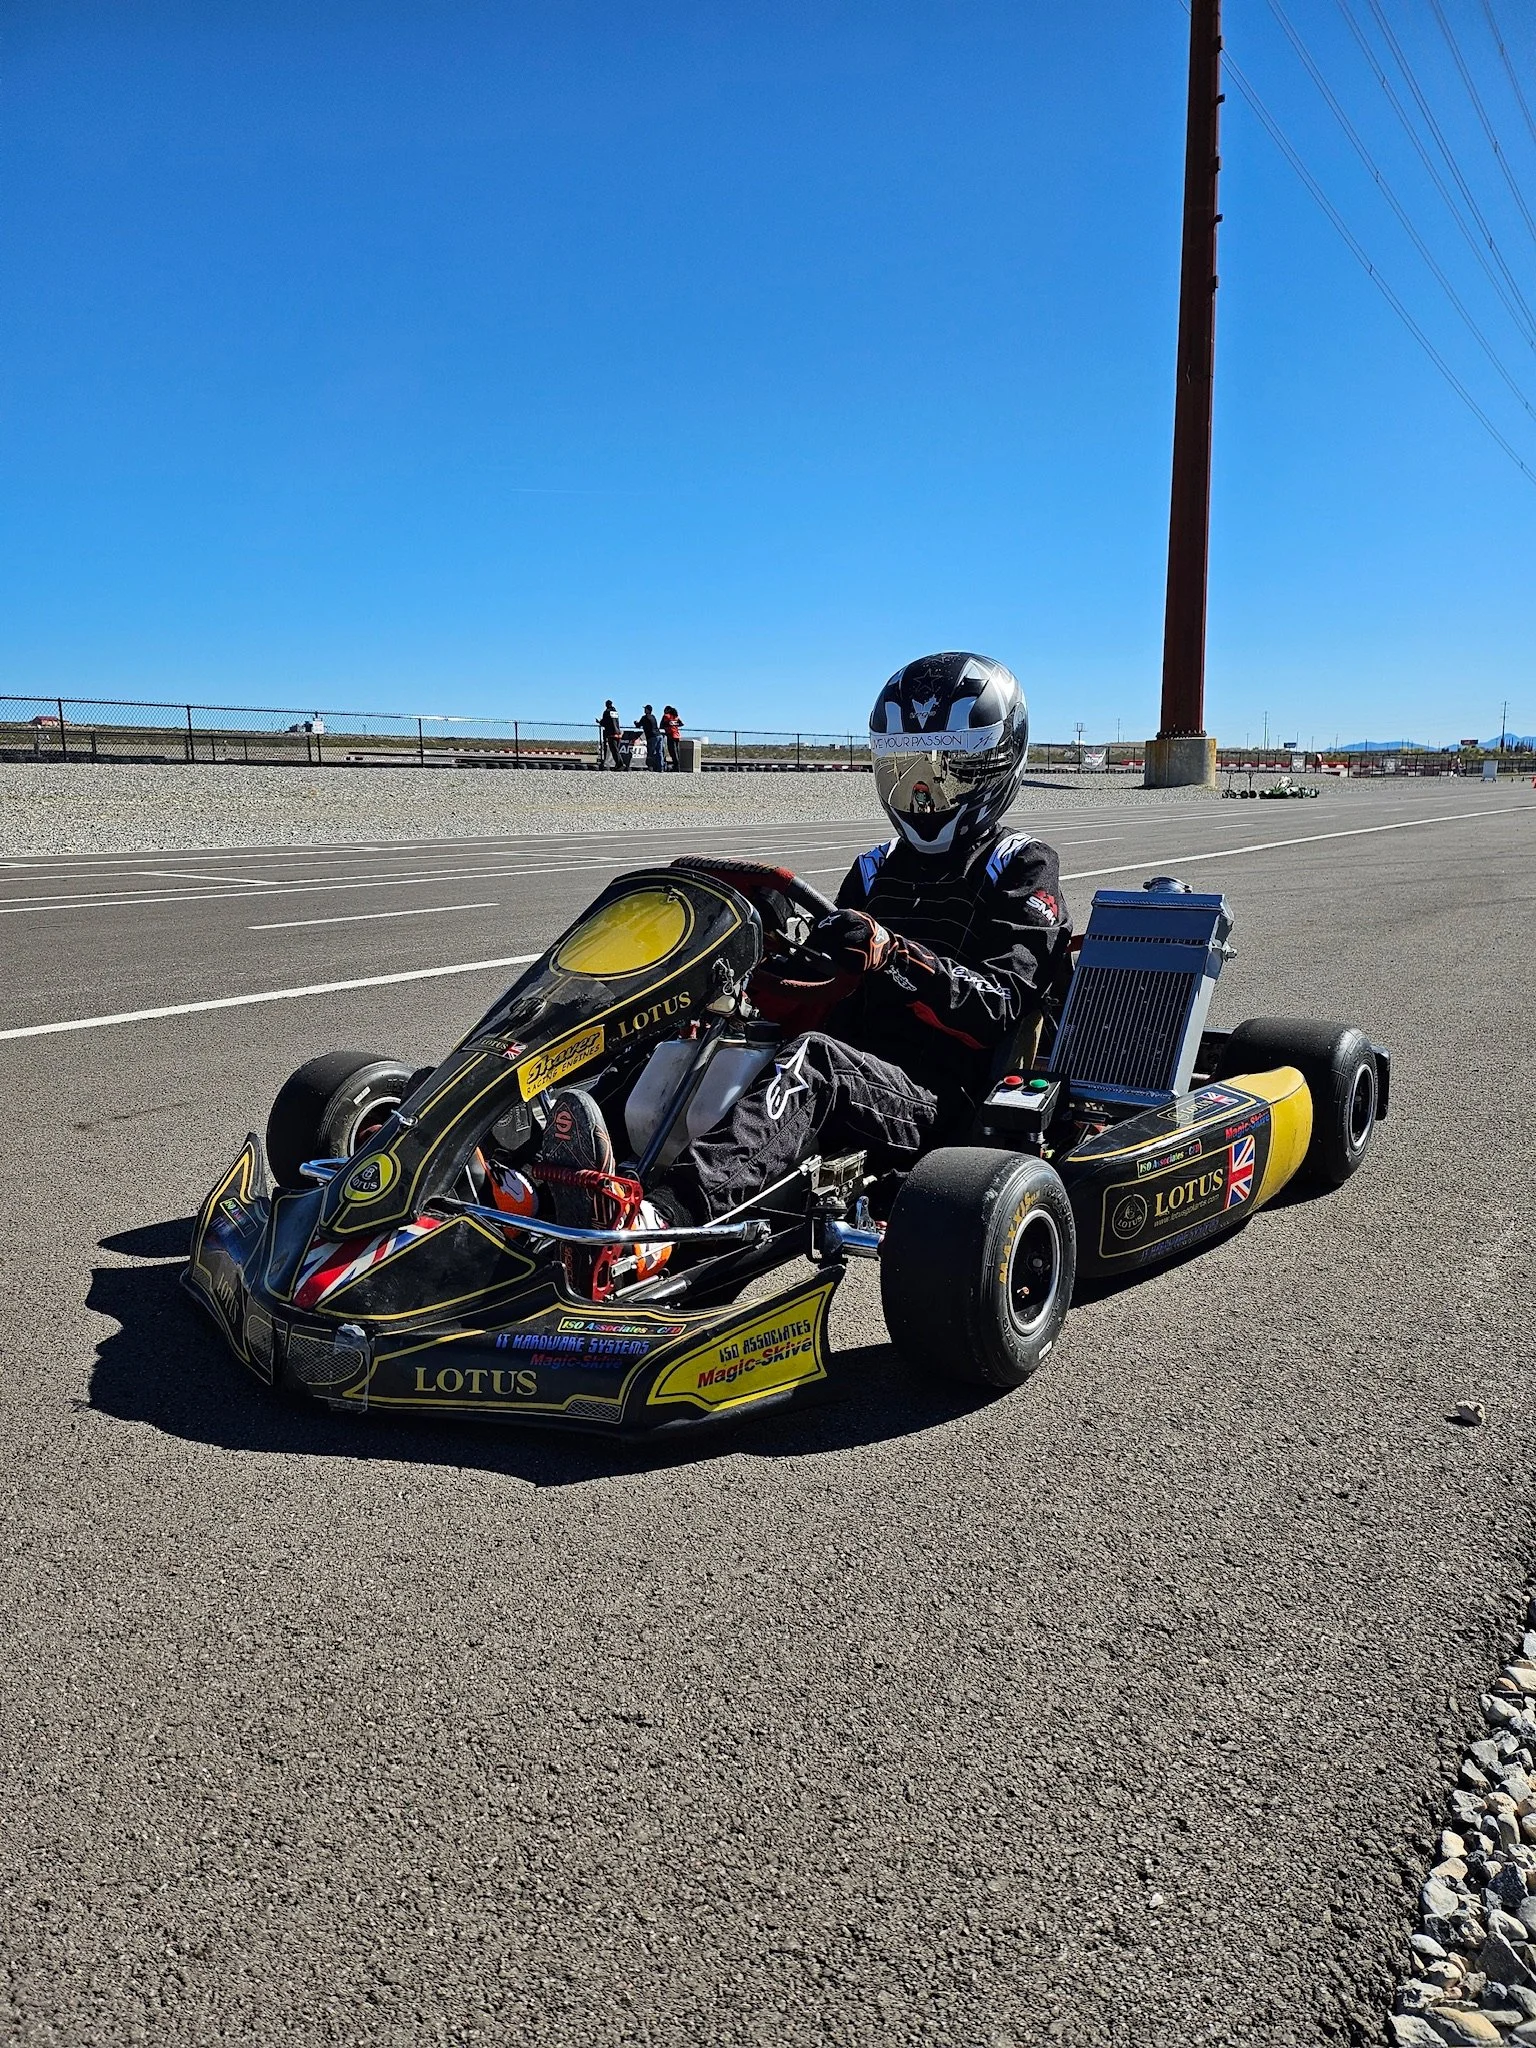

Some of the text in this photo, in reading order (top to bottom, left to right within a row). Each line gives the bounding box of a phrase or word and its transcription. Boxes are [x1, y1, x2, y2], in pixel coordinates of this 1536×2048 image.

[883, 737, 910, 750] YOUR
[911, 734, 962, 748] PASSION
[619, 991, 692, 1038] LOTUS
[481, 1038, 509, 1051] LOTUS
[526, 1031, 601, 1085] Shaver
[526, 1044, 601, 1096] RACING ENGINES
[1139, 1161, 1152, 1174] ISO
[1151, 1150, 1185, 1170] Associates
[352, 1176, 378, 1190] LOTUS
[1154, 1168, 1224, 1218] LOTUS
[1117, 1214, 1143, 1229] LOTUS
[998, 1192, 1032, 1285] MAXXIS
[562, 1320, 584, 1330] ISO
[585, 1322, 648, 1334] Associates
[496, 1333, 650, 1355] IT HARDWARE SYSTEMS
[720, 1319, 811, 1363] ISO ASSOCIATES
[529, 1353, 623, 1370] Magic-Skive
[697, 1337, 813, 1389] Magic-Skive
[414, 1367, 538, 1396] LOTUS
